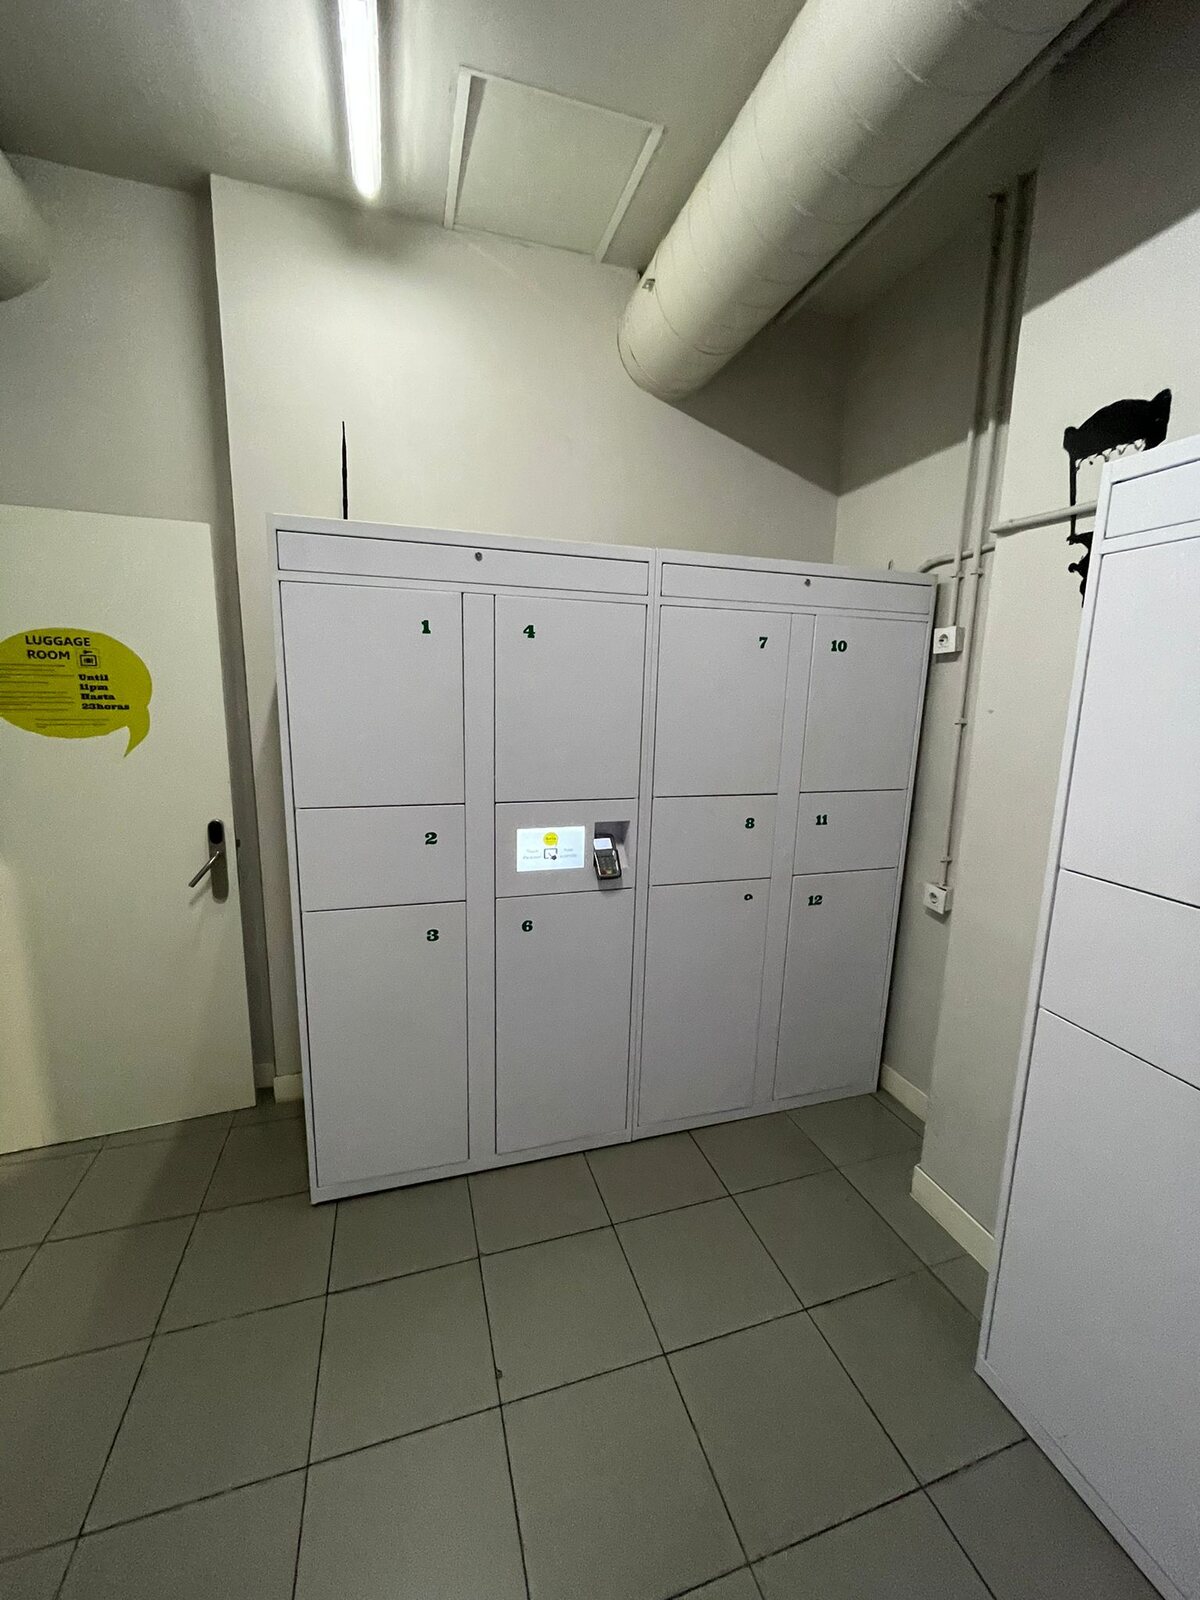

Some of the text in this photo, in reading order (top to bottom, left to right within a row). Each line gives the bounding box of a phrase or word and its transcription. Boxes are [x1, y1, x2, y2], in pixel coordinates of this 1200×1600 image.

[420, 620, 431, 634] 1
[523, 625, 536, 638] 4
[25, 635, 91, 647] LUGGAGE
[759, 637, 768, 649] 7
[831, 640, 848, 652] 10
[27, 650, 70, 660] ROOM
[78, 674, 109, 682] Until
[79, 684, 108, 692] 11pm
[745, 818, 755, 829] 8
[816, 815, 828, 826] 11
[425, 832, 437, 845] 2
[808, 895, 823, 906] 12
[522, 920, 534, 932] 6
[427, 929, 439, 942] 3
